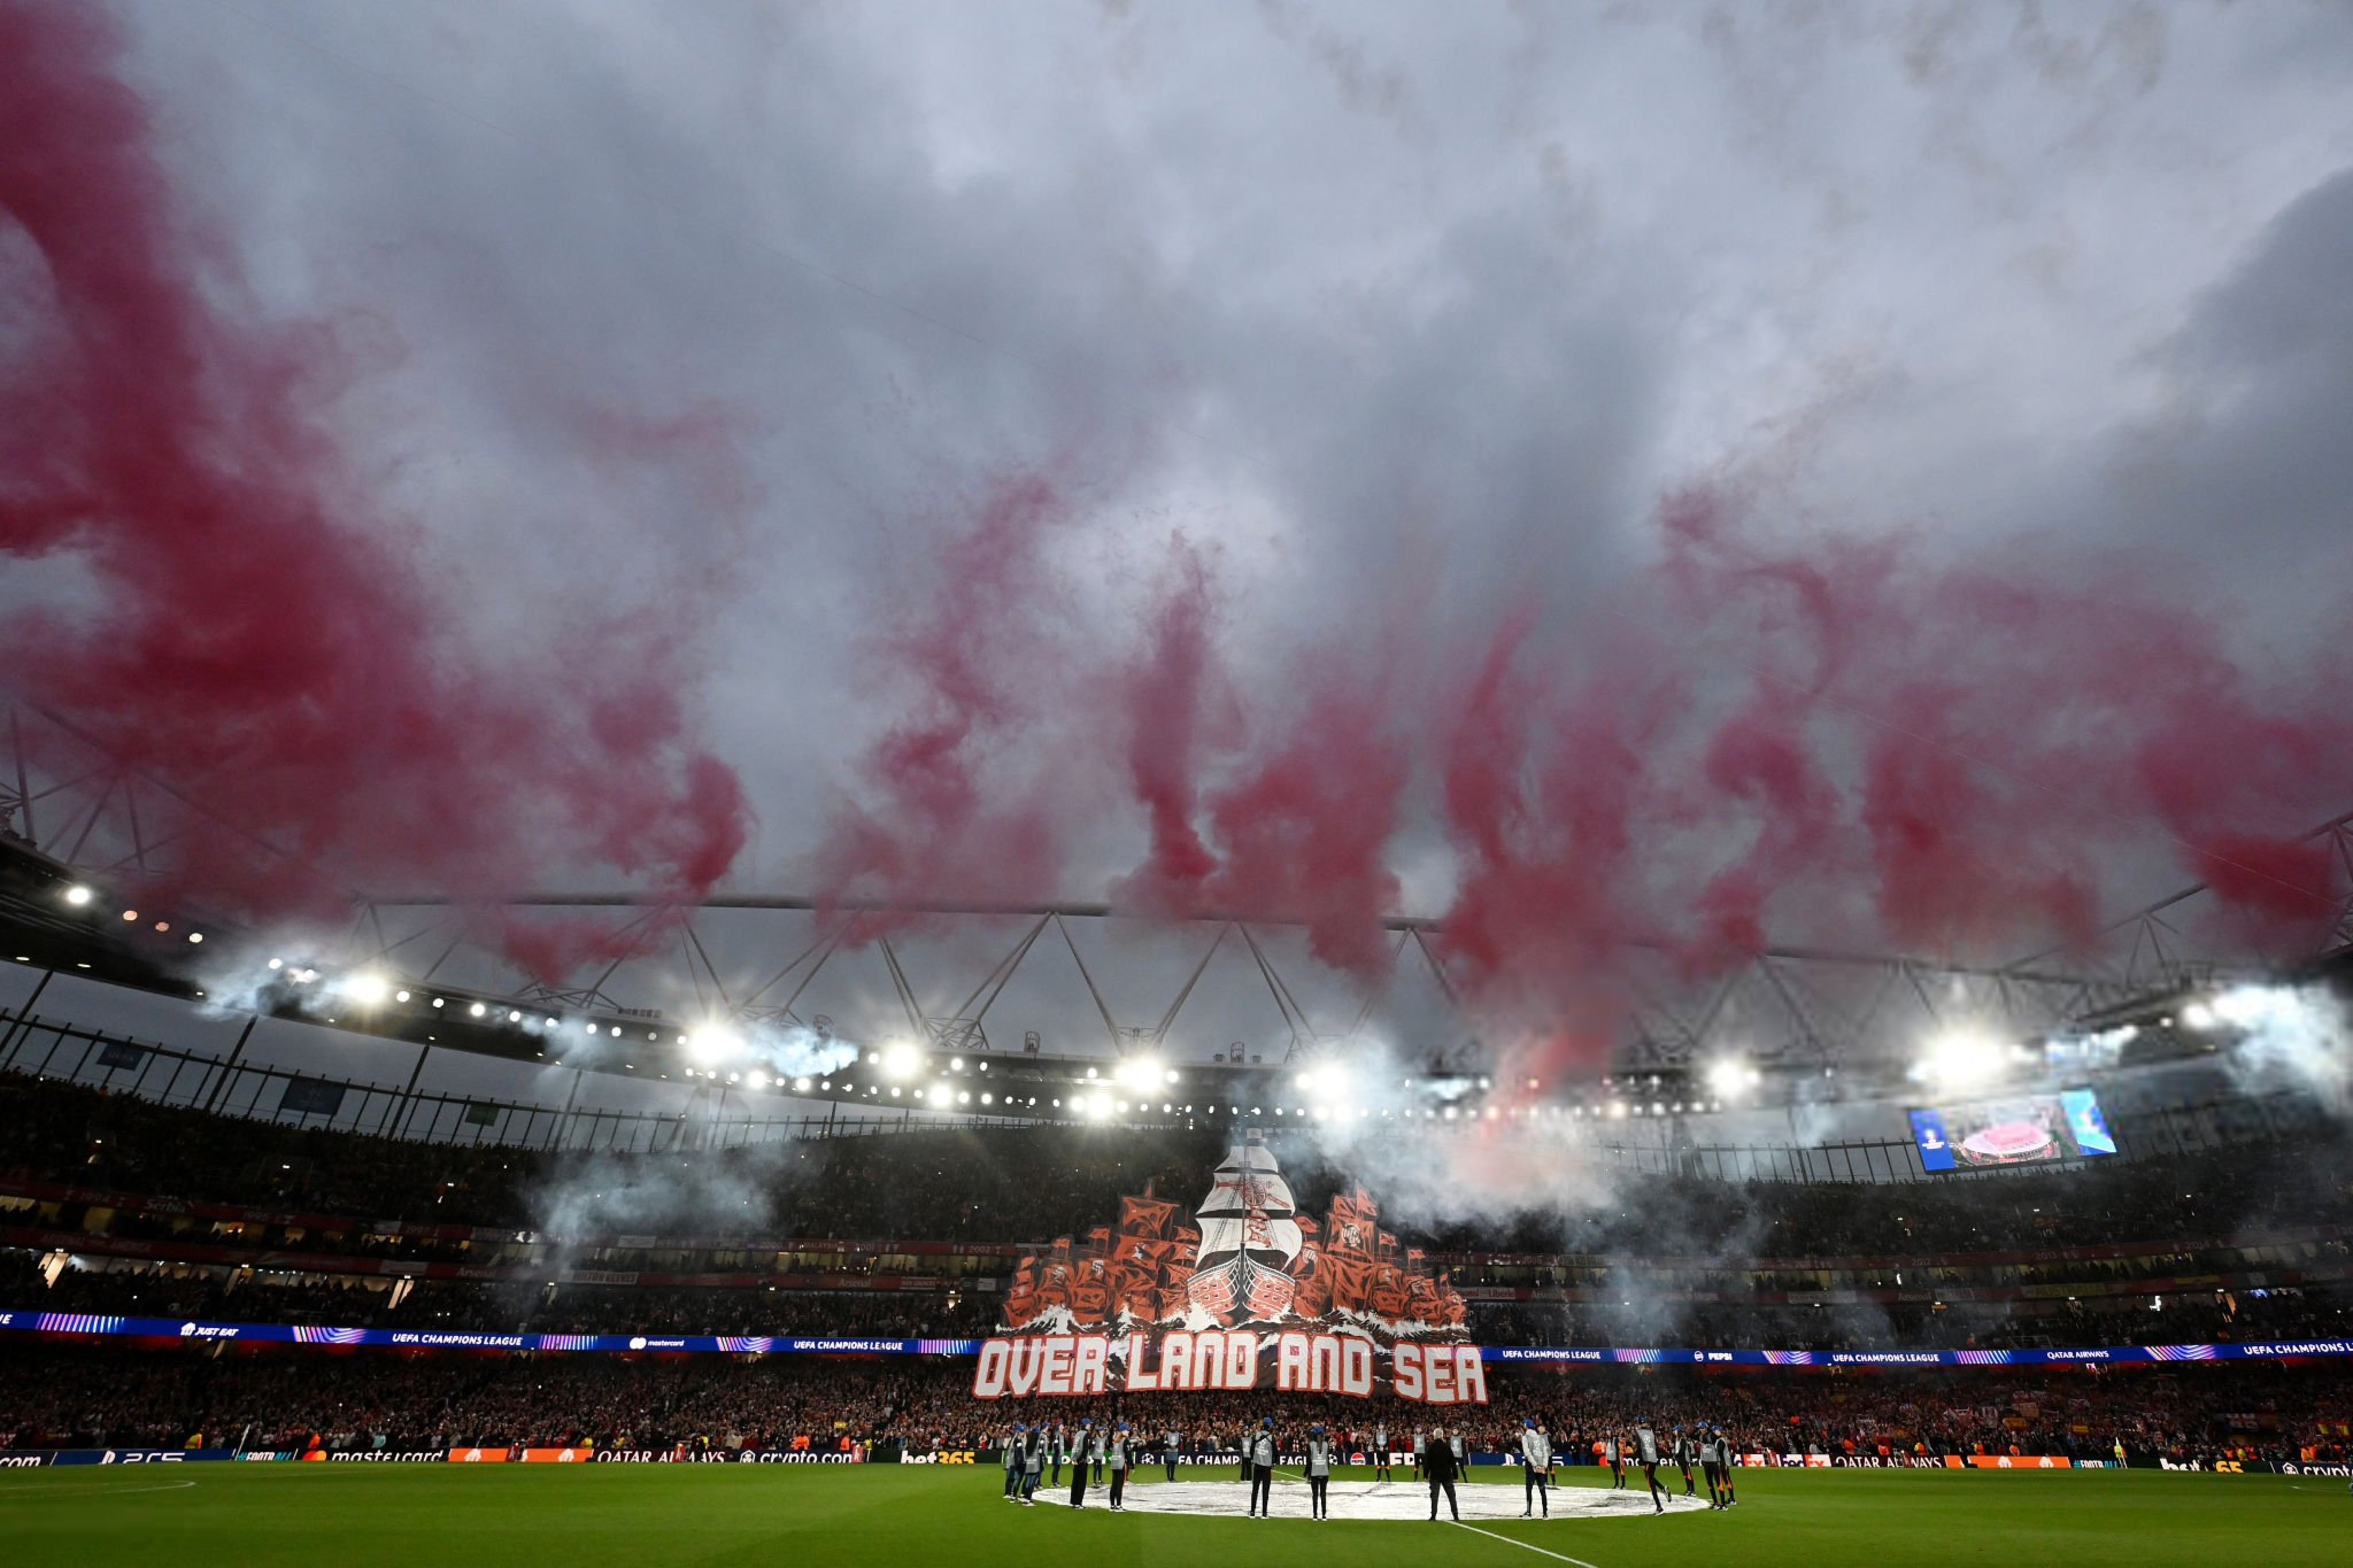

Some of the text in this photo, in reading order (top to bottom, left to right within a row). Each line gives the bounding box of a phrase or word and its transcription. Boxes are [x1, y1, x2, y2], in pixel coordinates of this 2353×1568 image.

[2034, 1250, 2057, 1260] 2013
[195, 1327, 239, 1338] JUST EAT
[392, 1333, 523, 1346] UEFA CHAMPIONS LEAGUE
[817, 1341, 869, 1350] CHAMPIONS
[869, 1342, 904, 1350] LEAGUE
[2244, 1342, 2353, 1355] UEFA CHAMPIONS L
[1524, 1350, 1570, 1359] CHAMPIONS
[1571, 1351, 1601, 1360] LEAGUE
[1708, 1353, 1733, 1361] PEPSI
[1855, 1354, 1905, 1362] CHAMPIONS
[2047, 1350, 2109, 1360] QATAR AIRWAYS
[973, 1330, 1489, 1405] OVER LAND AND SEA
[597, 1450, 653, 1462] QATAR
[2303, 1465, 2353, 1477] crypt
